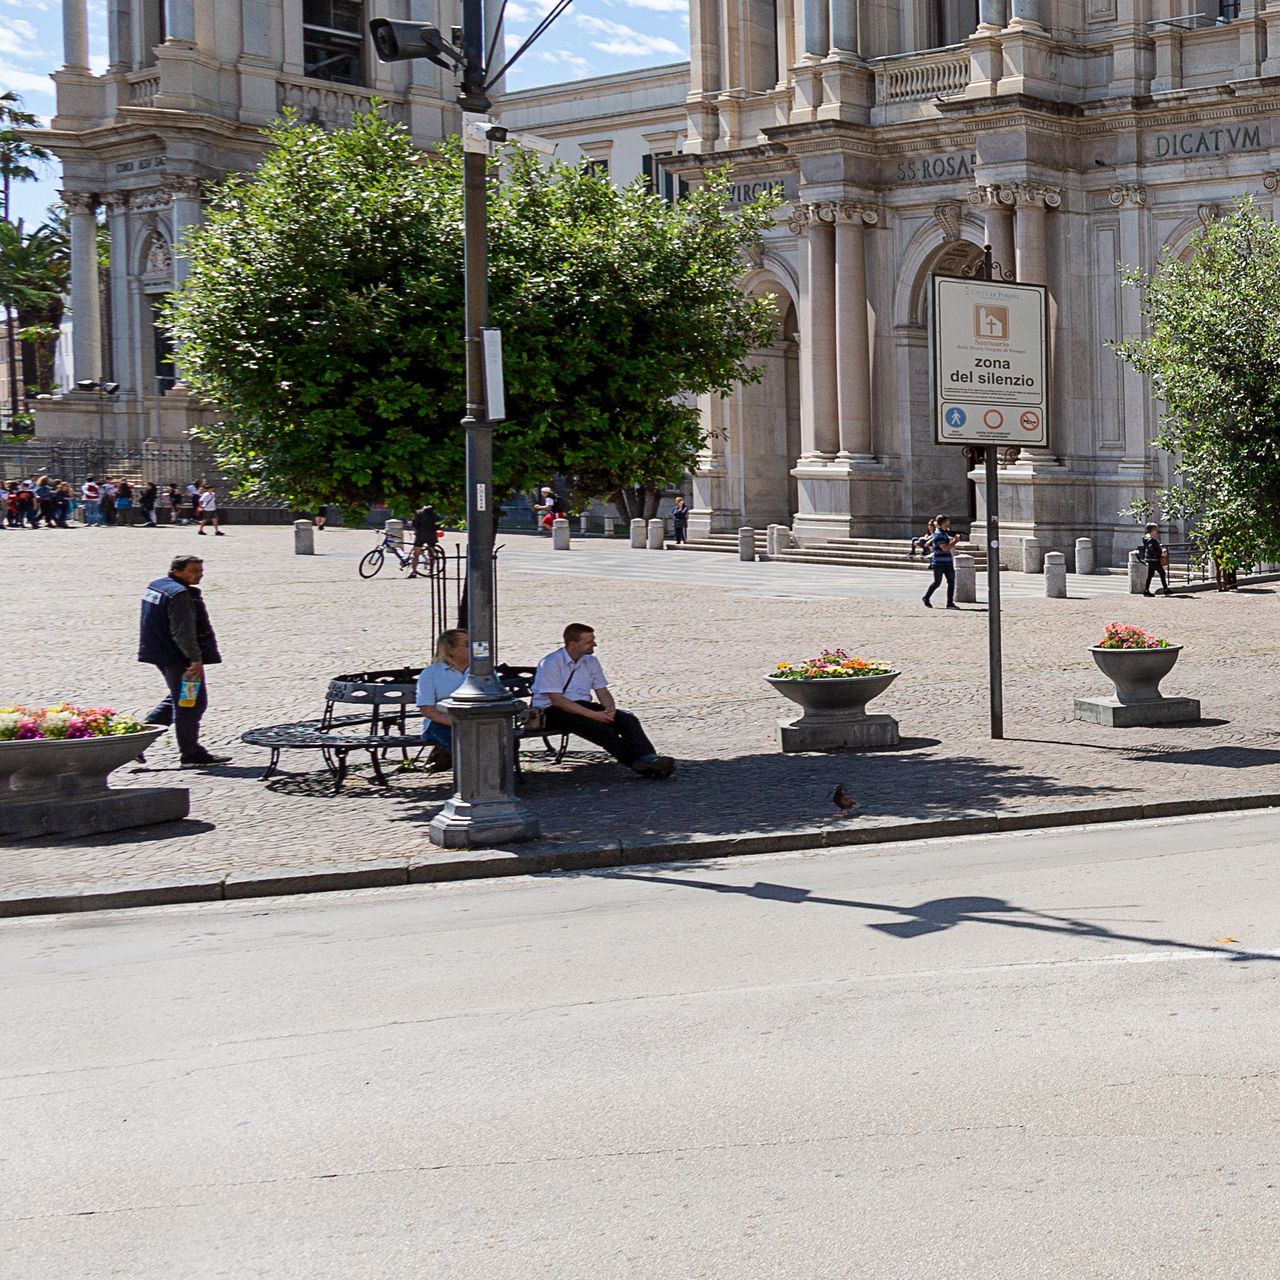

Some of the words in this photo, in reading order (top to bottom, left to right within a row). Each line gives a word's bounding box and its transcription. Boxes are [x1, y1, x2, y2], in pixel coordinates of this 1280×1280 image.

[1155, 125, 1261, 158] DICATVM
[974, 357, 1011, 370] zona
[950, 370, 973, 384] del
[978, 371, 1035, 387] silenzio
